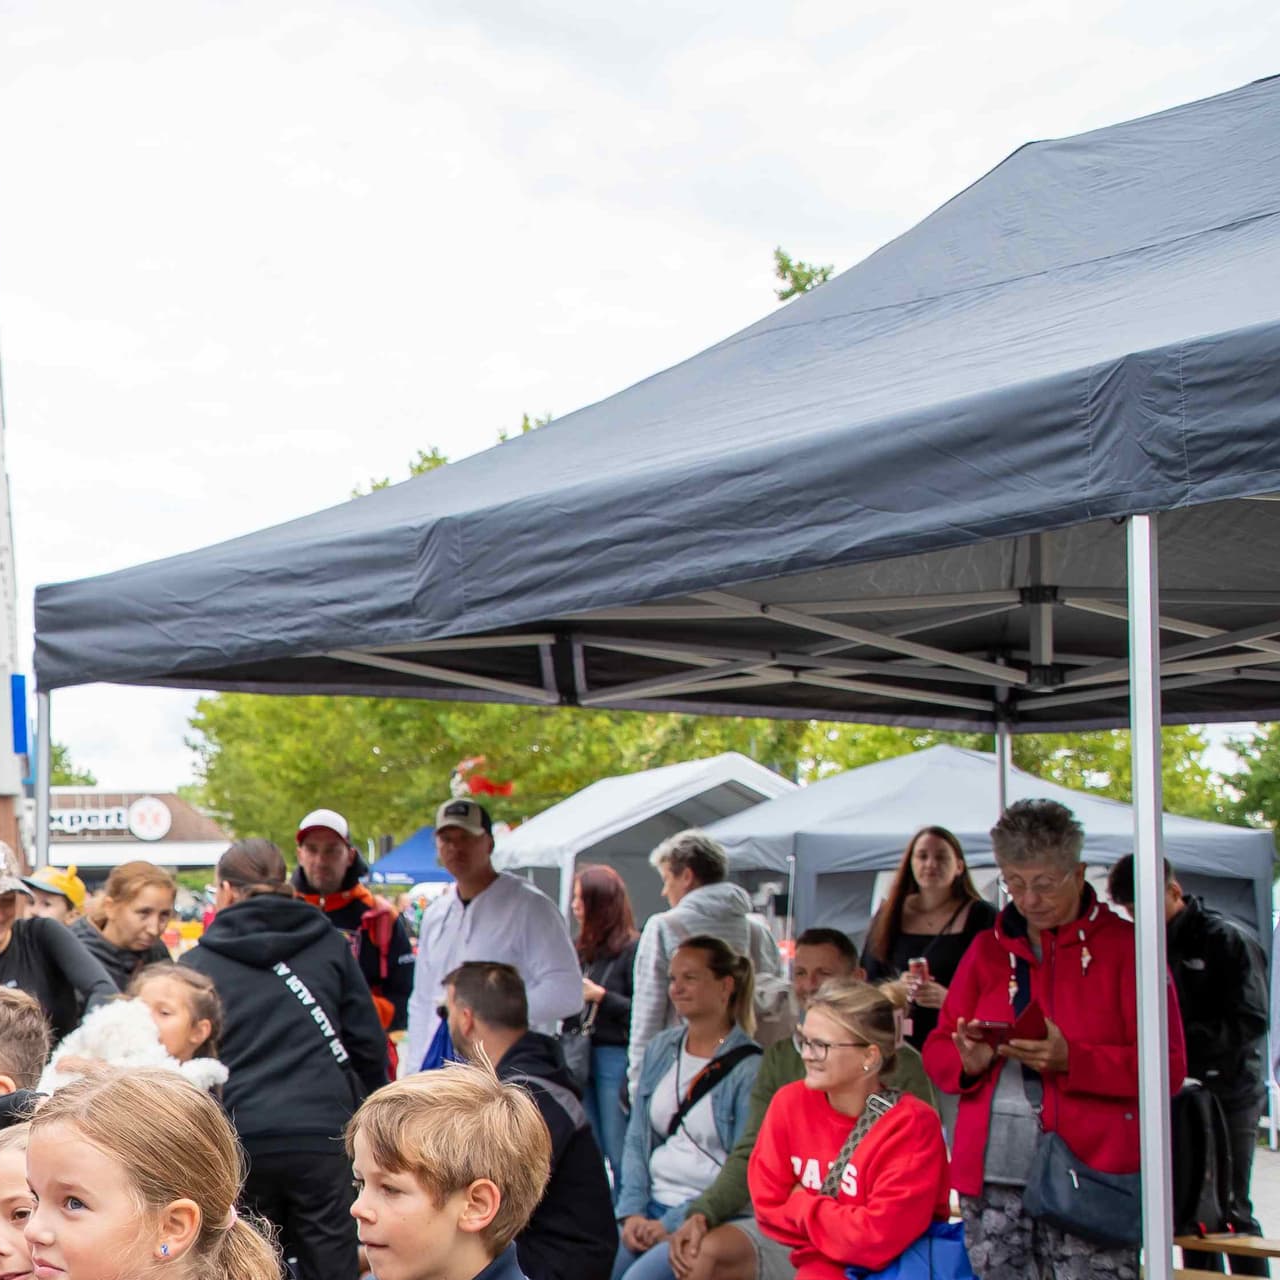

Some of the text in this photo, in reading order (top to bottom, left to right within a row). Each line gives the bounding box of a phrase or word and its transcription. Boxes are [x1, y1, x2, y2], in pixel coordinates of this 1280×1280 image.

[285, 974, 317, 1005] ALDI
[310, 1005, 336, 1037] ALDI
[789, 1154, 859, 1198] PAS
